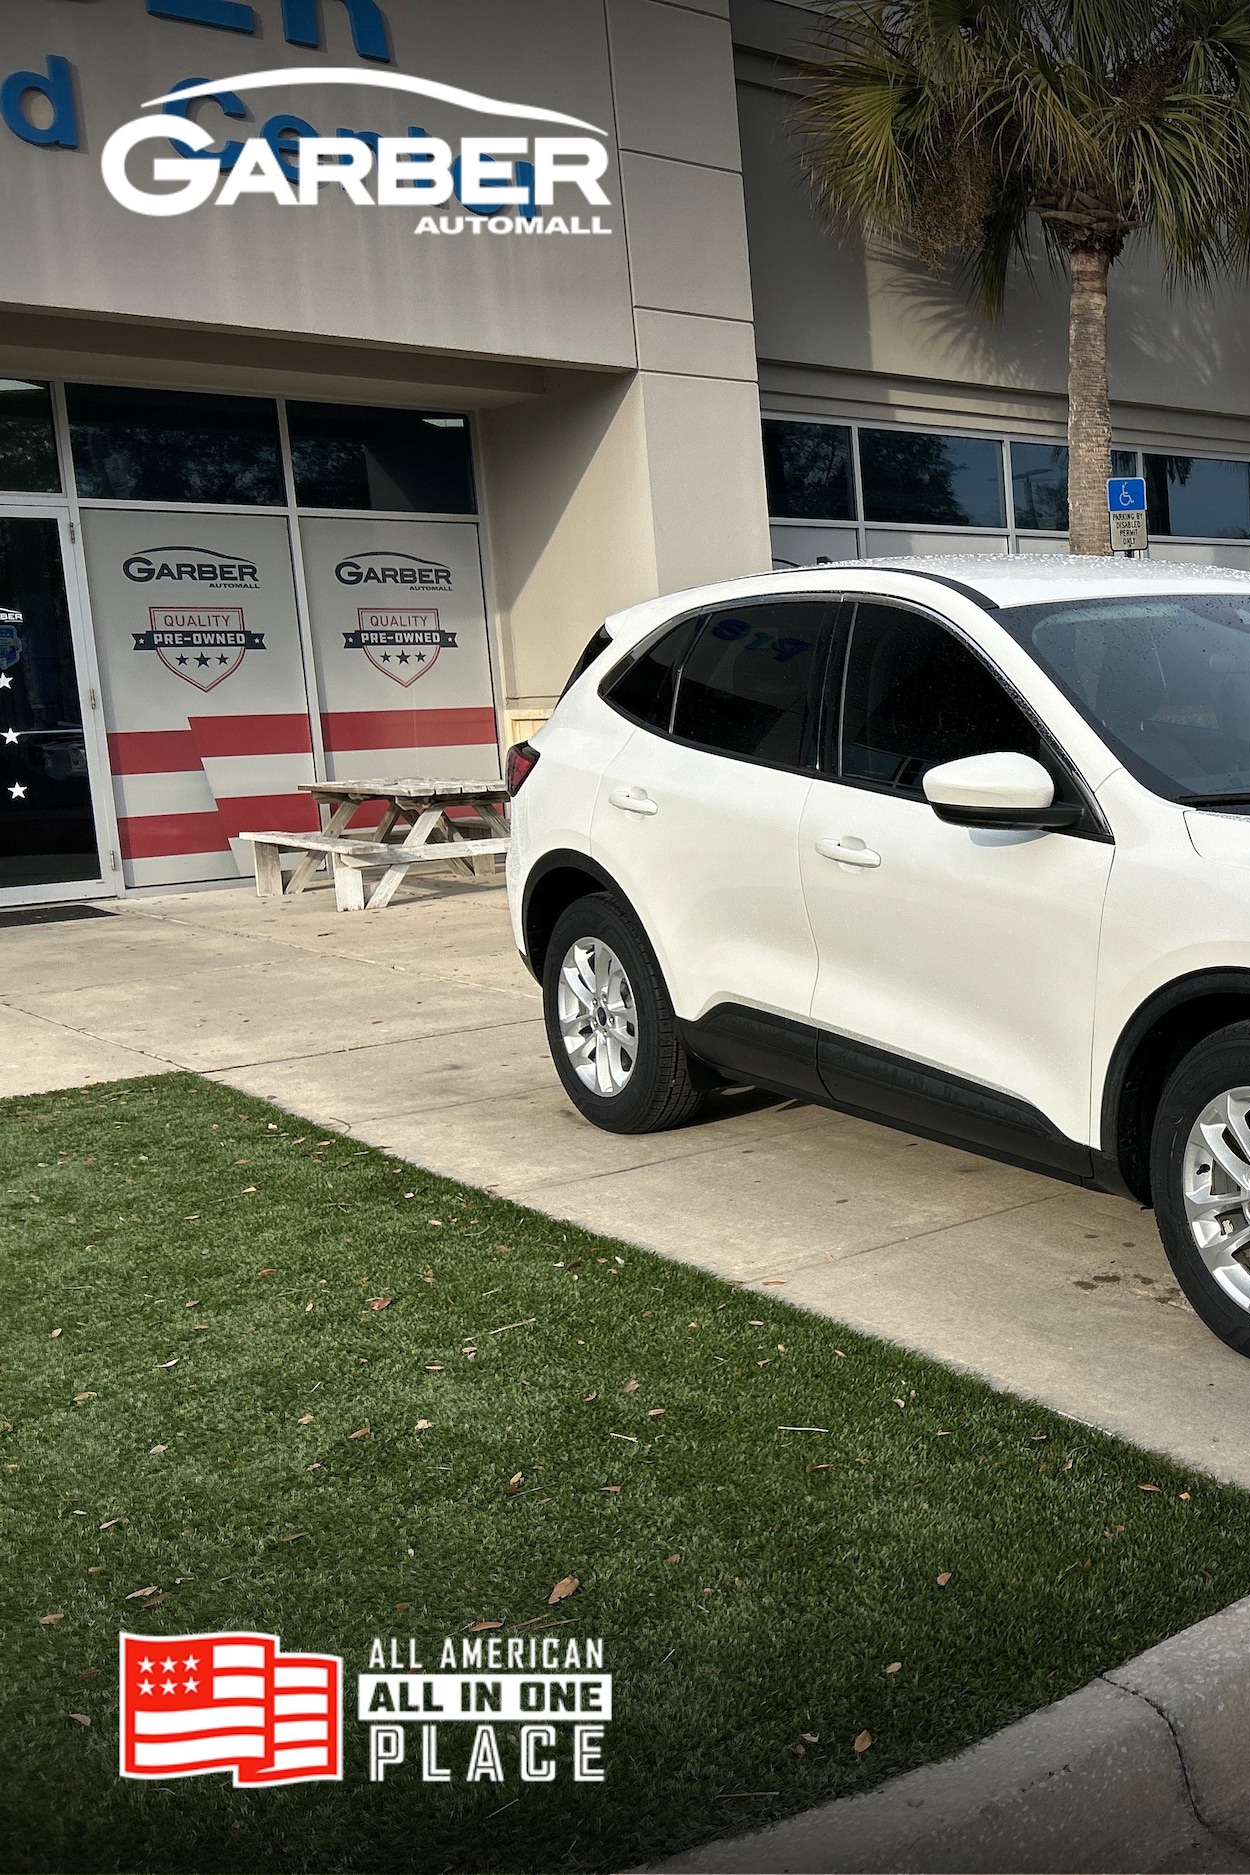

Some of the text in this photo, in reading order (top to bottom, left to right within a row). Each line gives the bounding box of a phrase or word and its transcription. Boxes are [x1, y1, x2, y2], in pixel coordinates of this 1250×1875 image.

[1112, 512, 1135, 521] PARKING
[1115, 520, 1141, 529] DISABLED
[1119, 529, 1138, 537] PERMIT
[123, 557, 259, 582] GARBER
[335, 562, 452, 585] GARBER
[0, 612, 23, 620] BER
[164, 615, 230, 627] QUALITY
[370, 615, 427, 627] QUALITY
[153, 633, 246, 645] PRE-OWNED
[361, 632, 440, 644] PRE-OWNED
